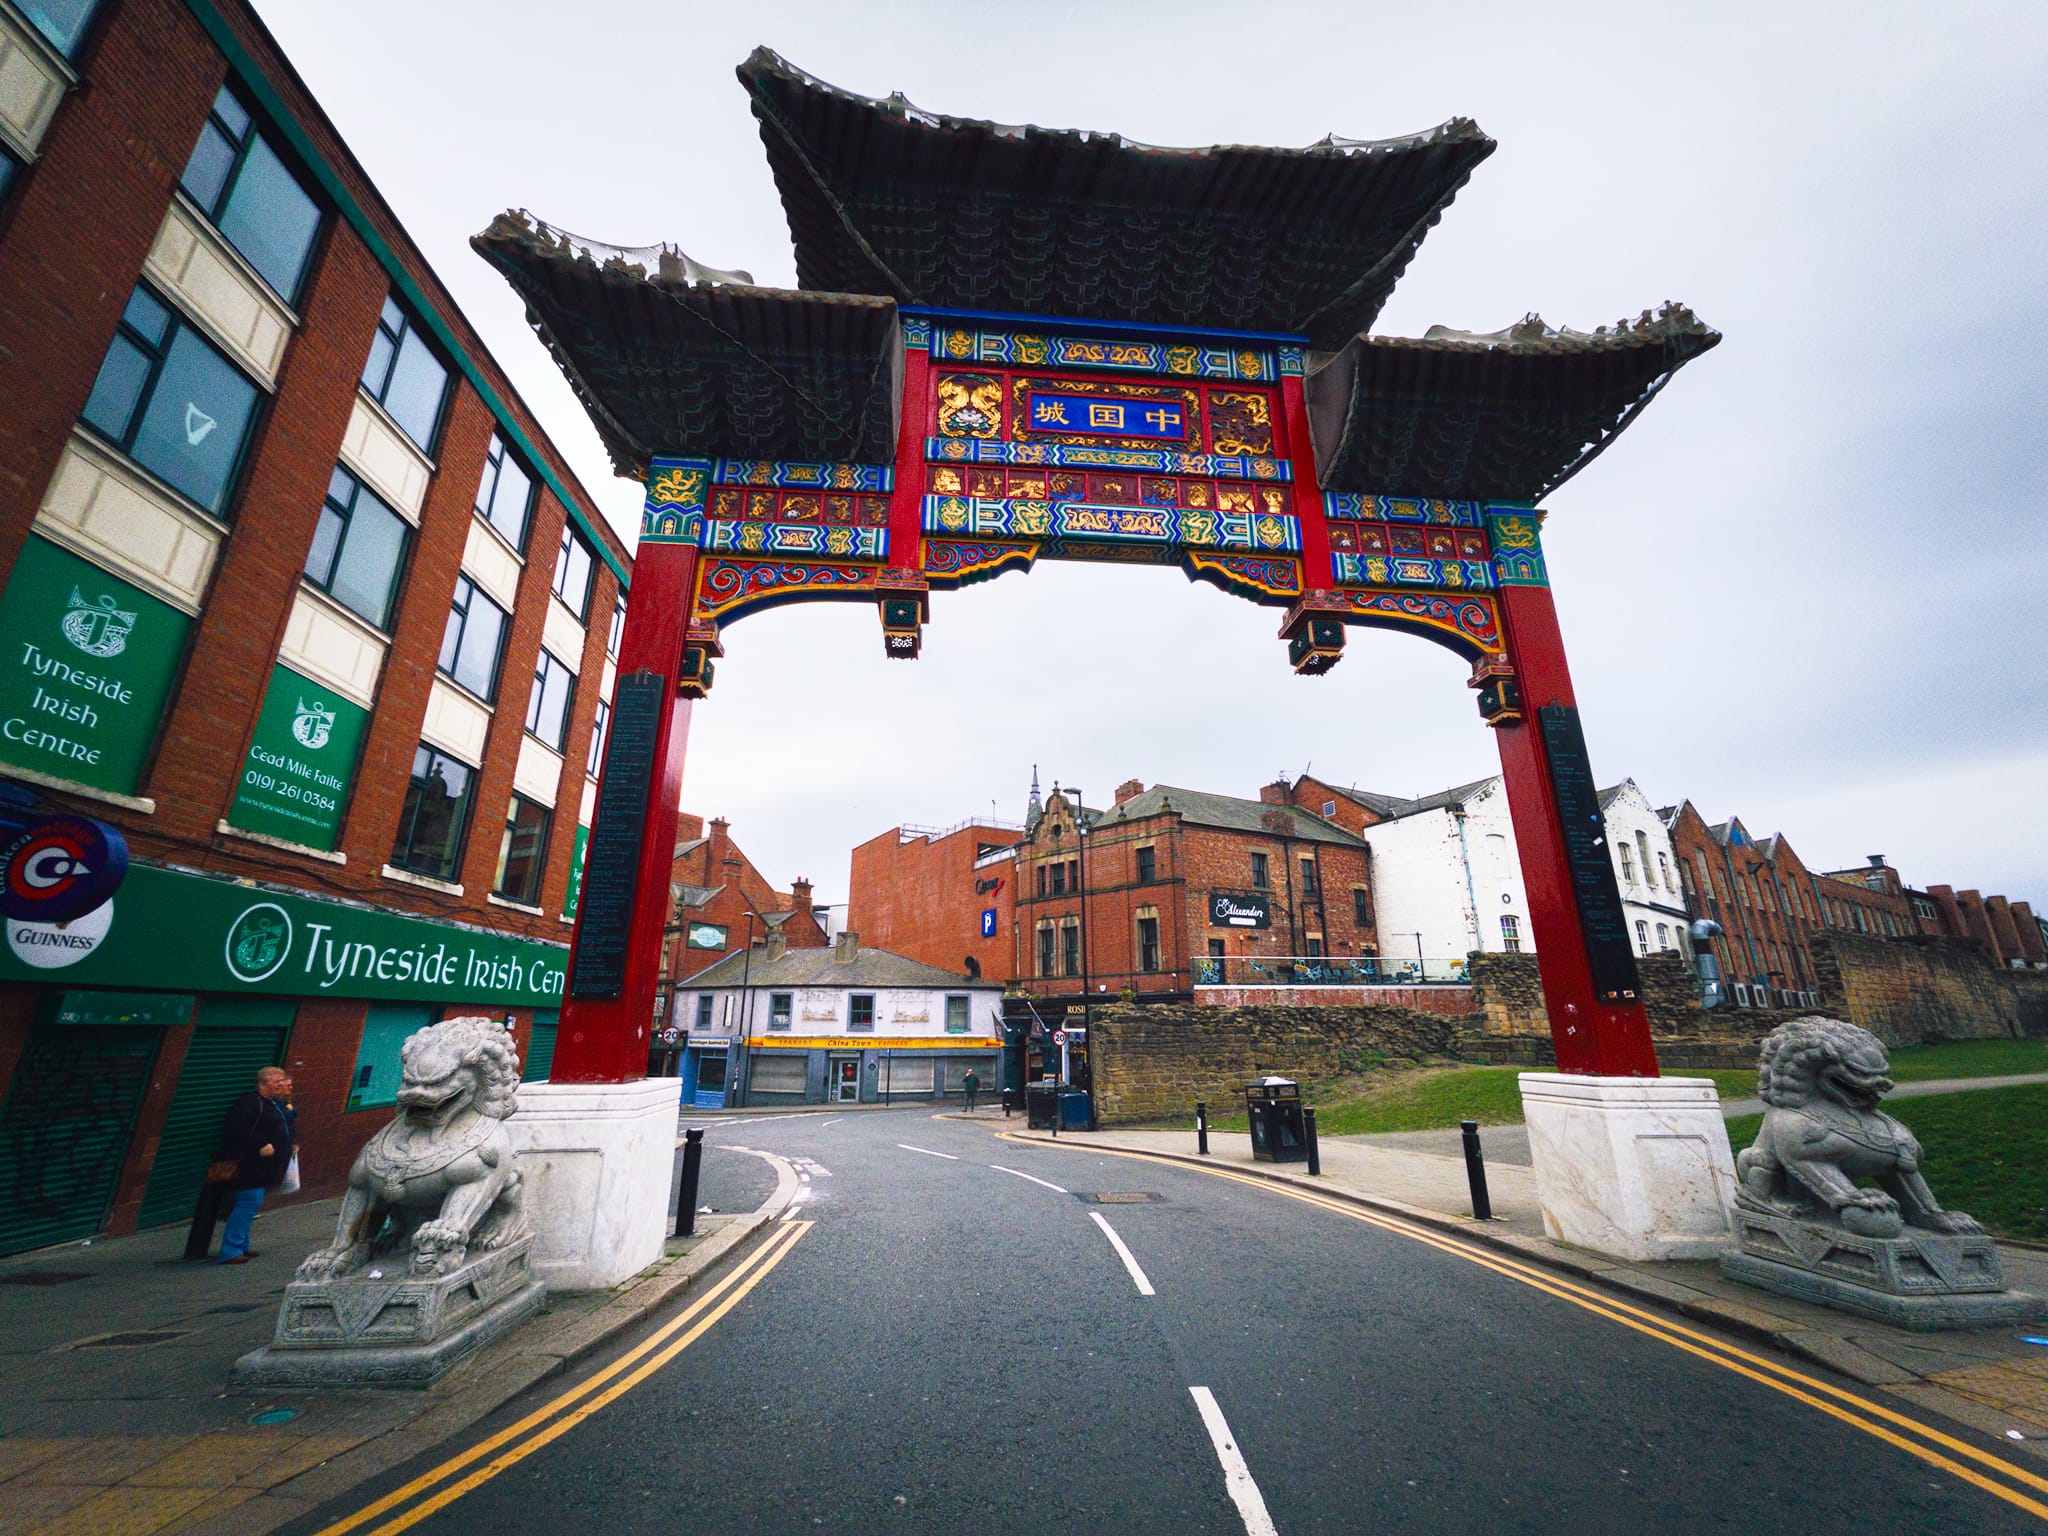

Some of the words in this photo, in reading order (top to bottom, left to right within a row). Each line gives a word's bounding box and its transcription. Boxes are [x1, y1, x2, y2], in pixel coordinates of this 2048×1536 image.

[23, 642, 133, 704] Tyneside
[32, 687, 99, 728] Irish
[3, 718, 103, 765] Centre
[250, 745, 286, 768] Cead
[286, 758, 313, 779] Mile
[313, 769, 344, 791] Failte
[246, 770, 276, 791] 0191
[277, 781, 302, 800] 261
[303, 790, 336, 812] 0384
[16, 928, 95, 950] GUINNESS
[304, 921, 459, 988] Tyneside
[464, 948, 524, 992] Irish
[529, 959, 566, 995] Cen
[665, 1031, 679, 1040] 20
[827, 1039, 849, 1047] China
[852, 1039, 871, 1047] Town
[1055, 1034, 1065, 1042] 20
